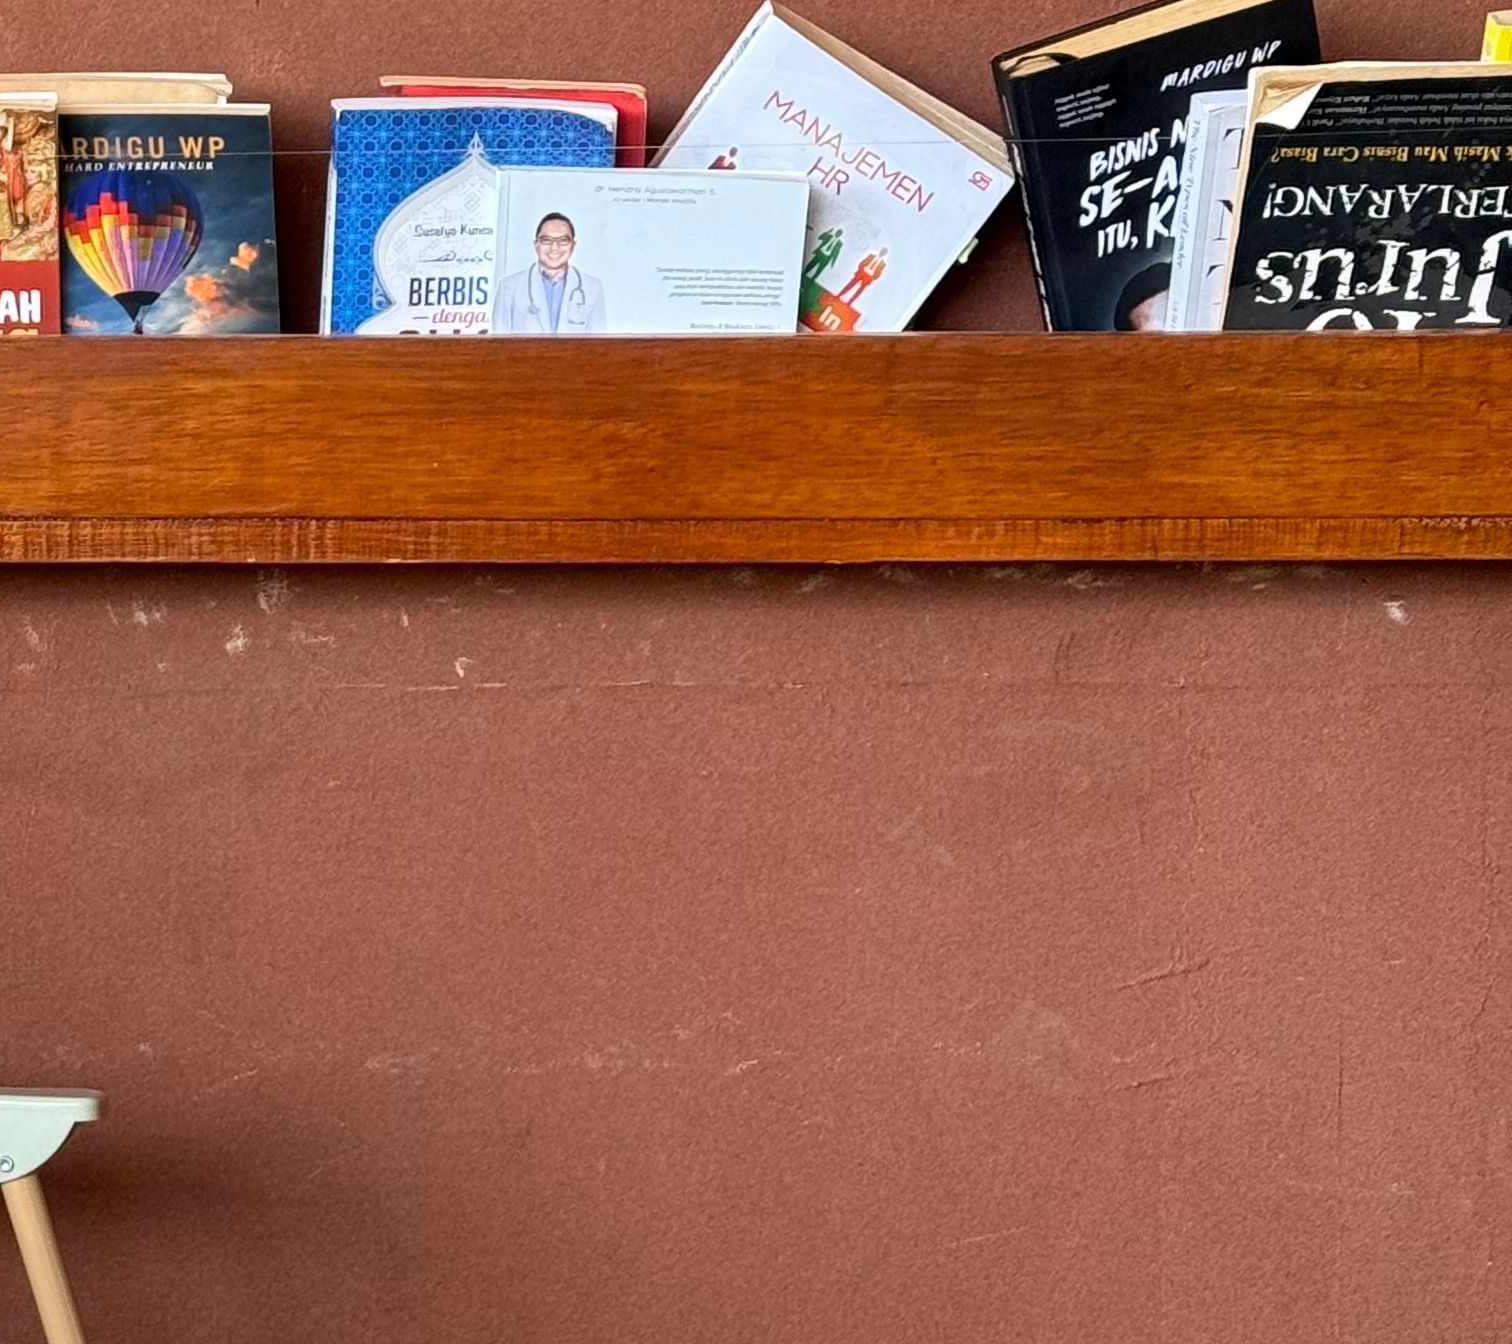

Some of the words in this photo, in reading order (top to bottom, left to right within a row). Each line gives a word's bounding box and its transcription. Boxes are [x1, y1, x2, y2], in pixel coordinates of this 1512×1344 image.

[1160, 50, 1248, 92] MARDIGU
[1251, 40, 1282, 63] WP
[179, 136, 226, 159] WP
[763, 90, 934, 212] MANAJEMEN
[1090, 127, 1161, 182] BISNIS
[1271, 146, 1319, 162] Biasa?
[1323, 146, 1360, 162] Cara
[1363, 146, 1409, 162] Bisnis
[1414, 146, 1449, 162] Mau
[1454, 146, 1501, 162] Masih
[108, 160, 215, 171] ENTREPRENEUR
[806, 156, 851, 195] HR
[1097, 219, 1139, 258] ITU,
[1254, 229, 1512, 324] Jurus
[408, 276, 489, 307] BERBIS
[432, 308, 490, 329] denga
[818, 305, 841, 331] In
